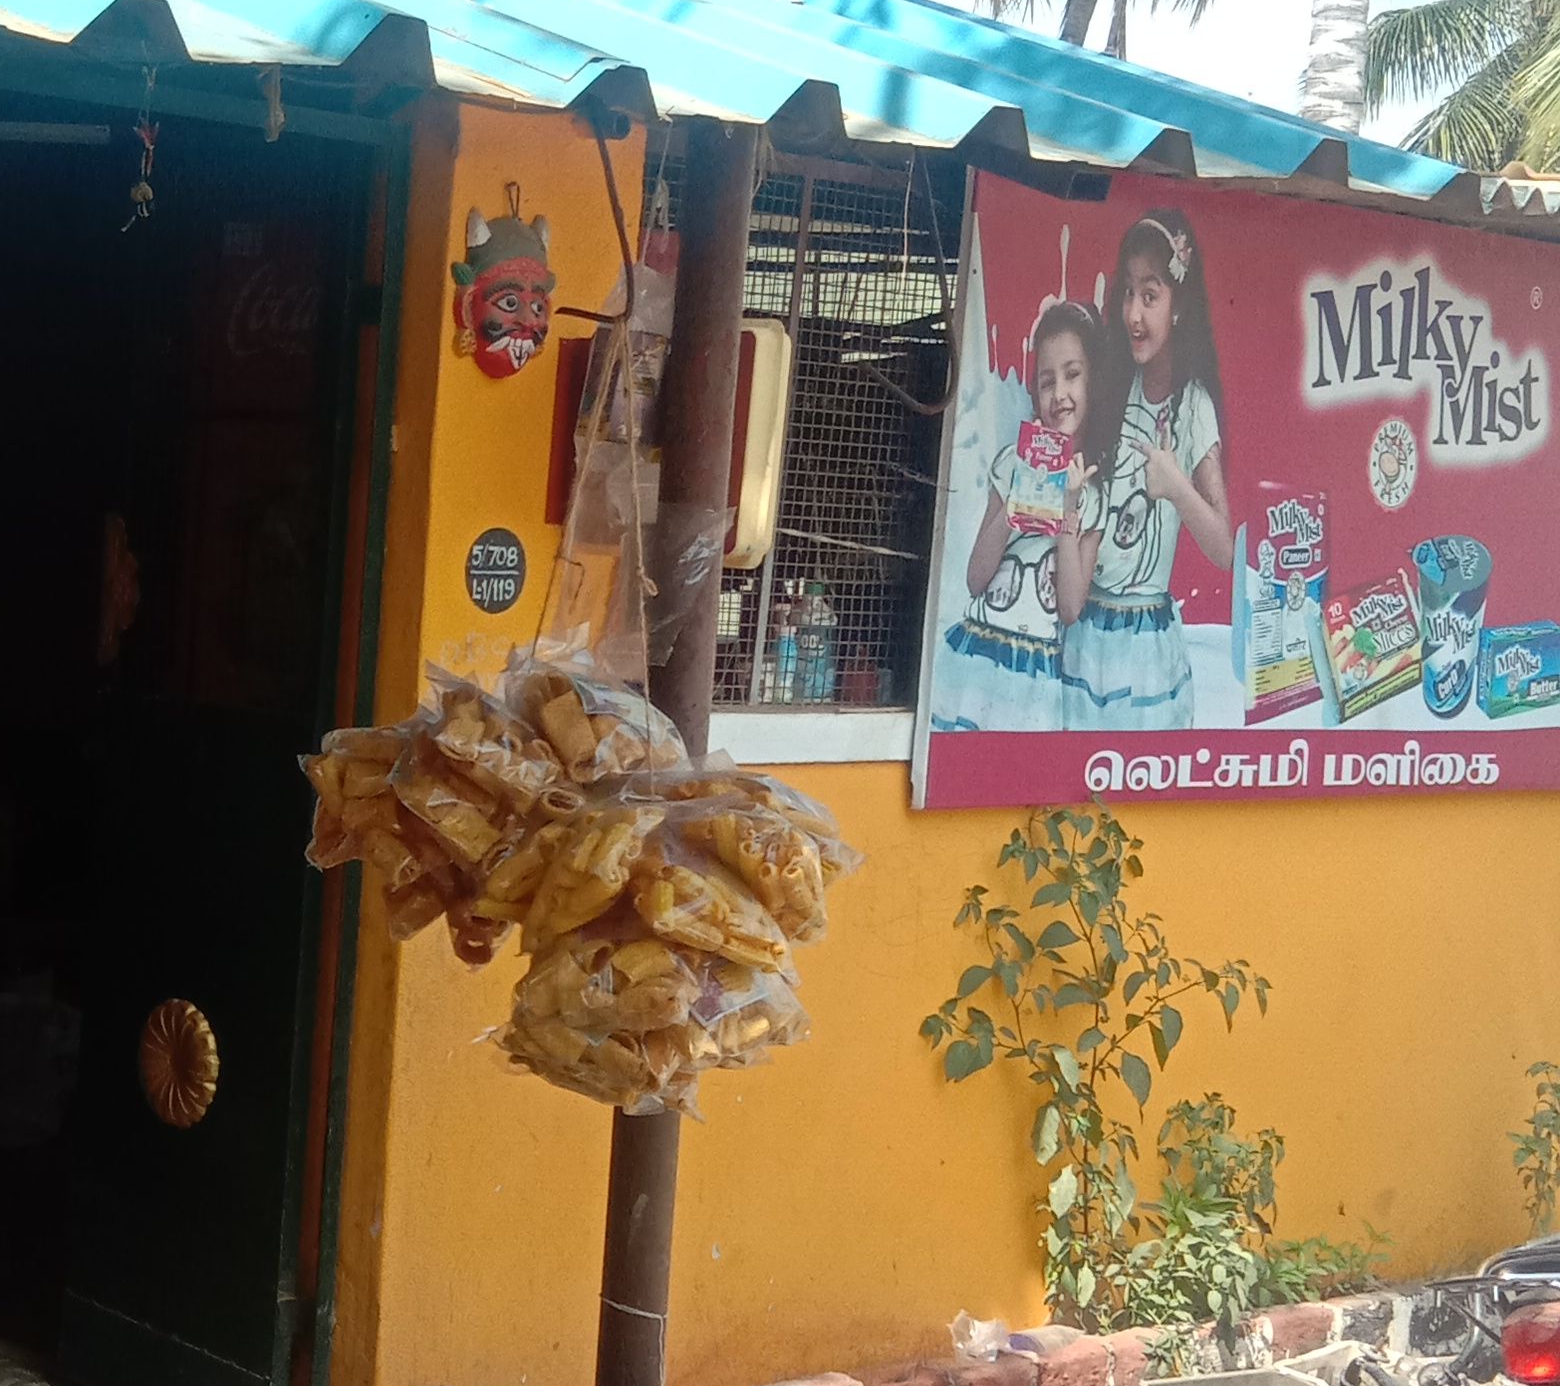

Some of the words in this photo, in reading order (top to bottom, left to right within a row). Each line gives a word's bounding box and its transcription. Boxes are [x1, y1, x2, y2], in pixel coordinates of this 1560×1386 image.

[1310, 264, 1482, 400] Milky
[1437, 351, 1541, 449] Mist
[1374, 423, 1413, 455] PREMIUM
[1374, 479, 1409, 504] FRESH
[1269, 500, 1308, 536] Milky
[471, 543, 518, 568] 5/708
[1283, 551, 1310, 564] Paneer
[1329, 602, 1342, 617] 10
[1353, 595, 1387, 623] Milky
[1427, 612, 1465, 642] Milky
[1497, 646, 1530, 673] Milky
[1530, 679, 1560, 697] Butter
[1084, 740, 1309, 795] லெட்சுமி
[1324, 738, 1500, 790] மளிகை
